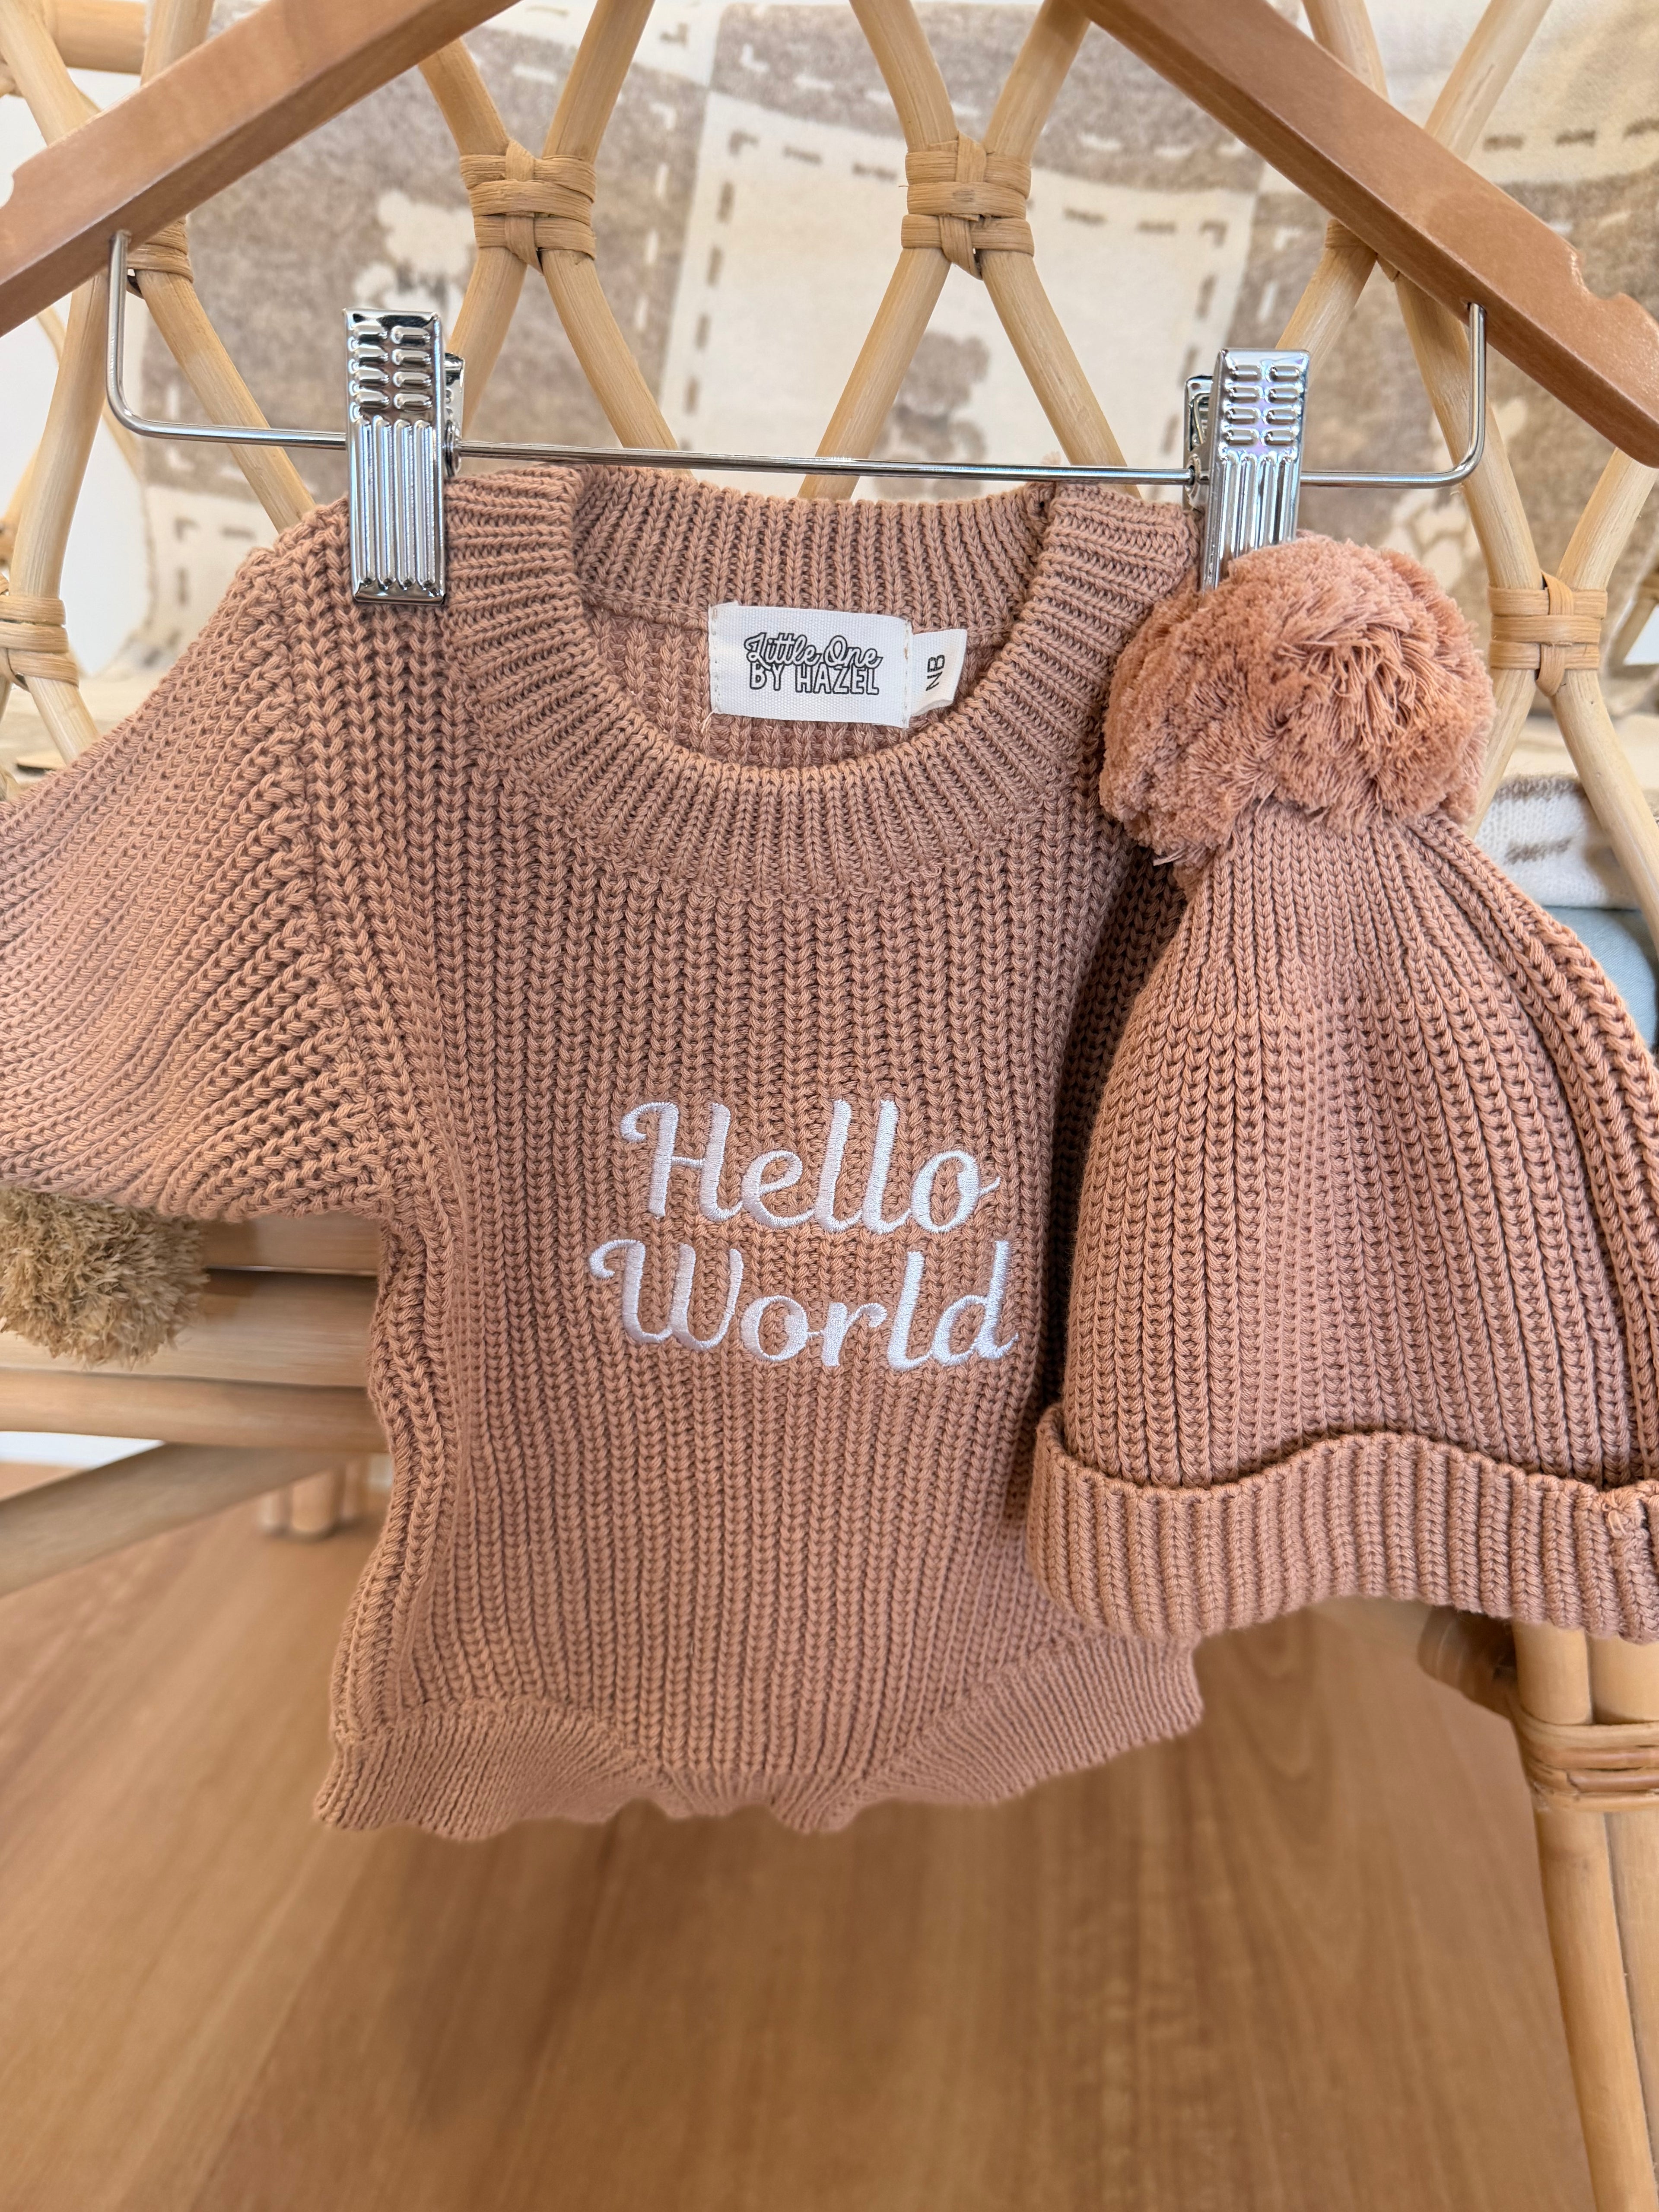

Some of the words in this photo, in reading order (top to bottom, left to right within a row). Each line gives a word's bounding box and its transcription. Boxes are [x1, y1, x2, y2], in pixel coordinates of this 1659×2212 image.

[744, 632, 820, 669] Little
[823, 635, 883, 668] One
[749, 661, 790, 691] BY
[795, 664, 880, 695] HAZEL
[925, 654, 945, 692] NB
[621, 1100, 1000, 1235] Hello
[589, 1239, 1019, 1371] World
